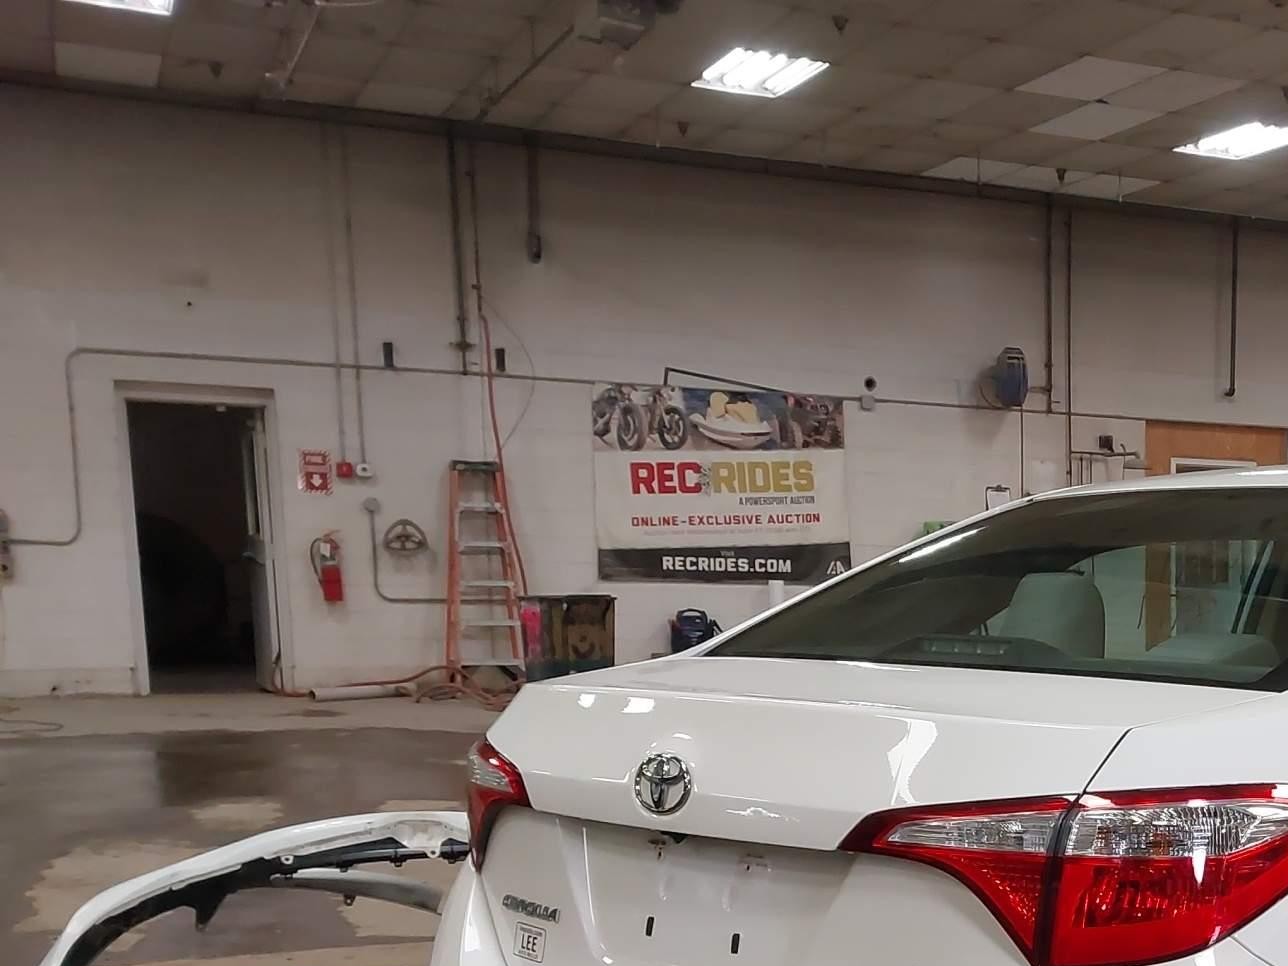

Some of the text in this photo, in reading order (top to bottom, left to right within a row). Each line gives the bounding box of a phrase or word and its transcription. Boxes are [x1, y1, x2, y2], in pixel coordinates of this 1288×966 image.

[630, 461, 815, 494] REC RIDES
[739, 497, 744, 505] A
[790, 495, 815, 505] AUCTION
[631, 513, 821, 527] ONLINE-EXCLUSIVE AUCTION
[662, 556, 792, 573] RECRIDES.COM
[520, 932, 539, 953] LEE
